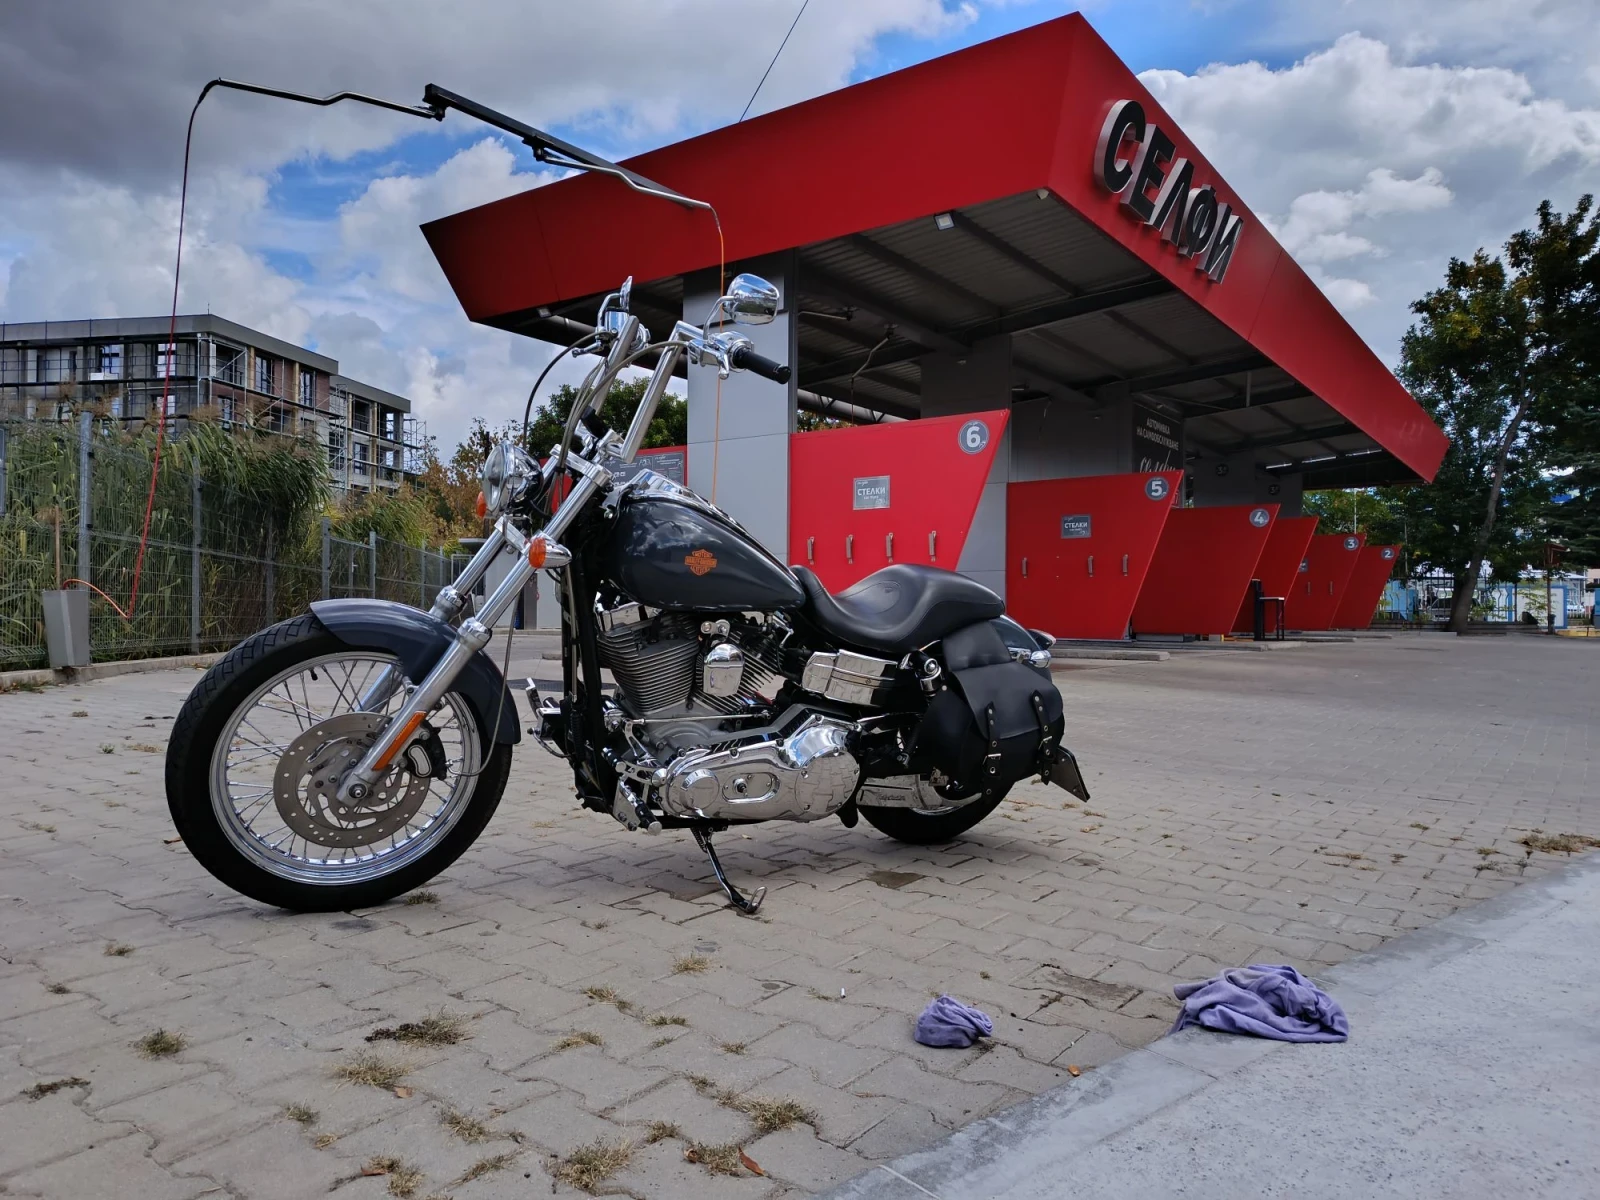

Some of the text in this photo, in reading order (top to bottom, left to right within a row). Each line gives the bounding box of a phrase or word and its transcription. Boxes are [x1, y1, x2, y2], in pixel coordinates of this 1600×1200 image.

[1094, 99, 1244, 284] СЕЛФИ
[966, 426, 980, 448] 6
[857, 486, 886, 496] СТЕЛКИ
[1152, 481, 1162, 496] 5
[1254, 512, 1264, 524] 4
[1348, 539, 1355, 548] 3
